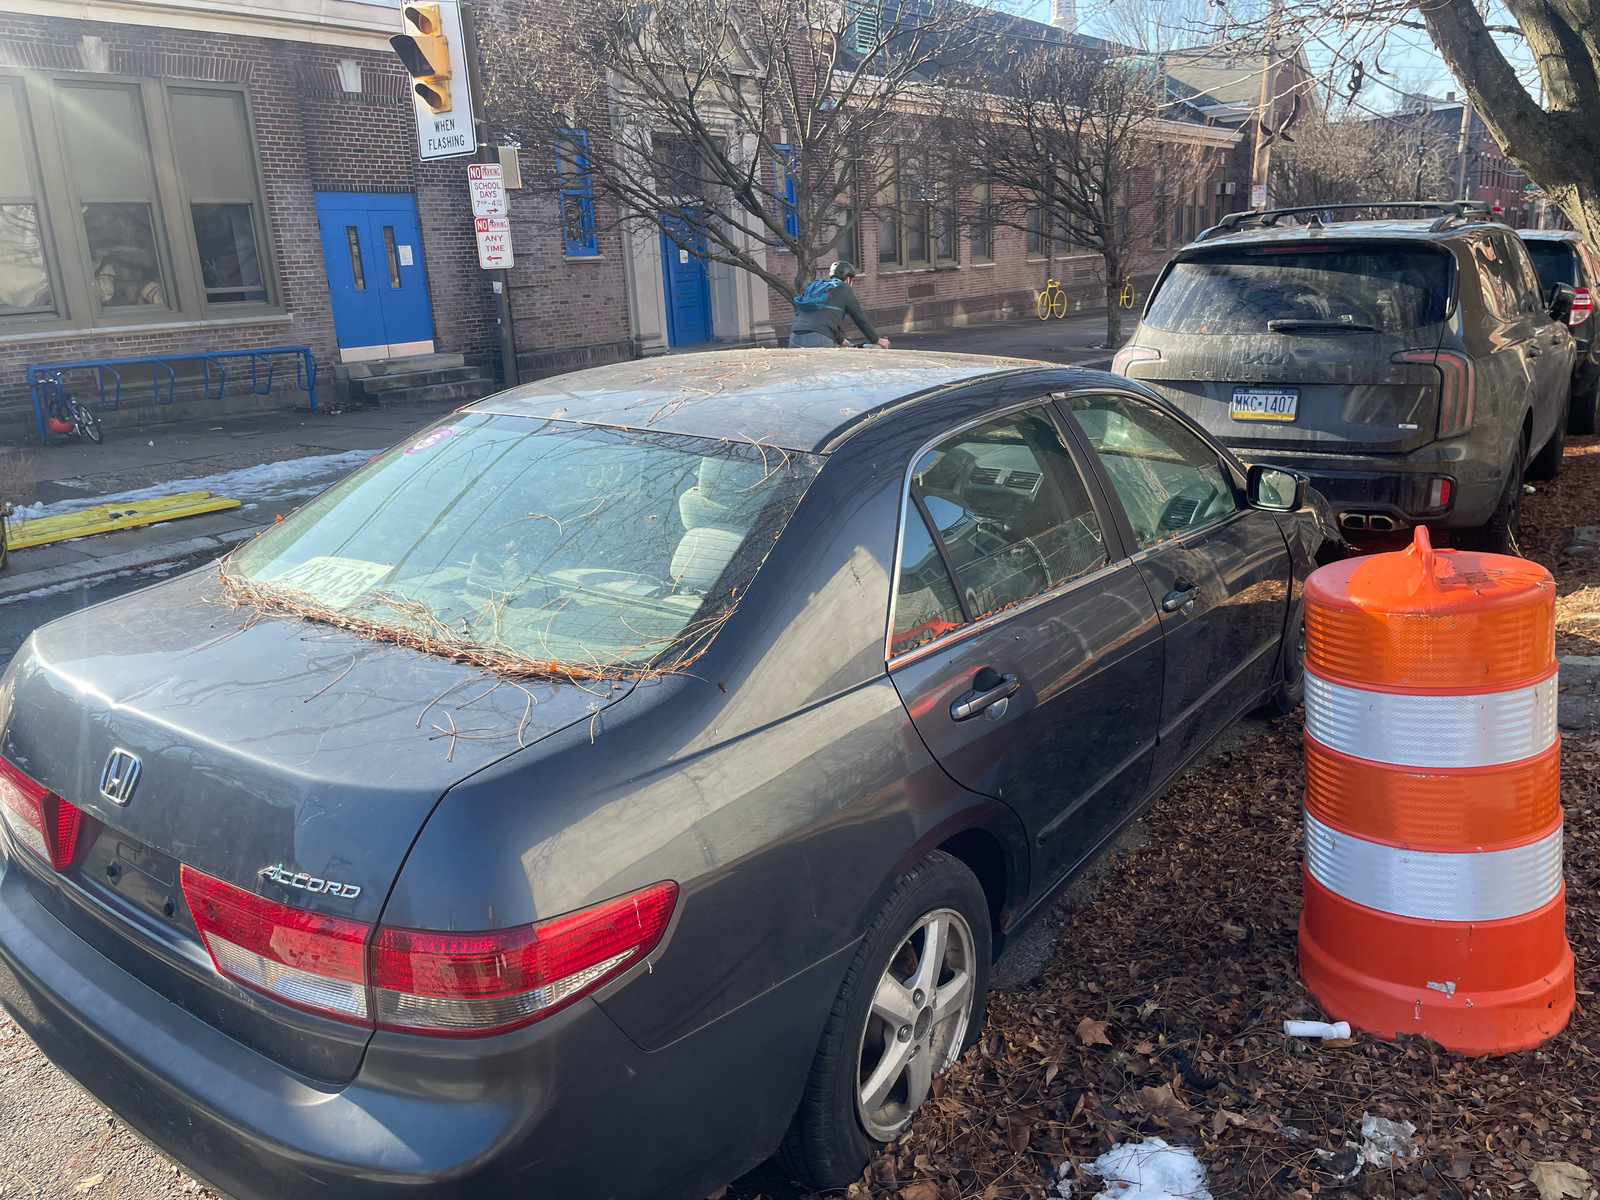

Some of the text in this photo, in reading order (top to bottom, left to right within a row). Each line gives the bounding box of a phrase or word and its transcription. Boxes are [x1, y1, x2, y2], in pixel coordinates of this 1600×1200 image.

[434, 119, 455, 132] WHEN
[429, 135, 464, 150] FLASHING
[470, 167, 500, 178] NO PARKING
[474, 182, 501, 190] SCHOOL
[476, 220, 507, 230] NO PARKING
[258, 866, 361, 898] ACCORD
